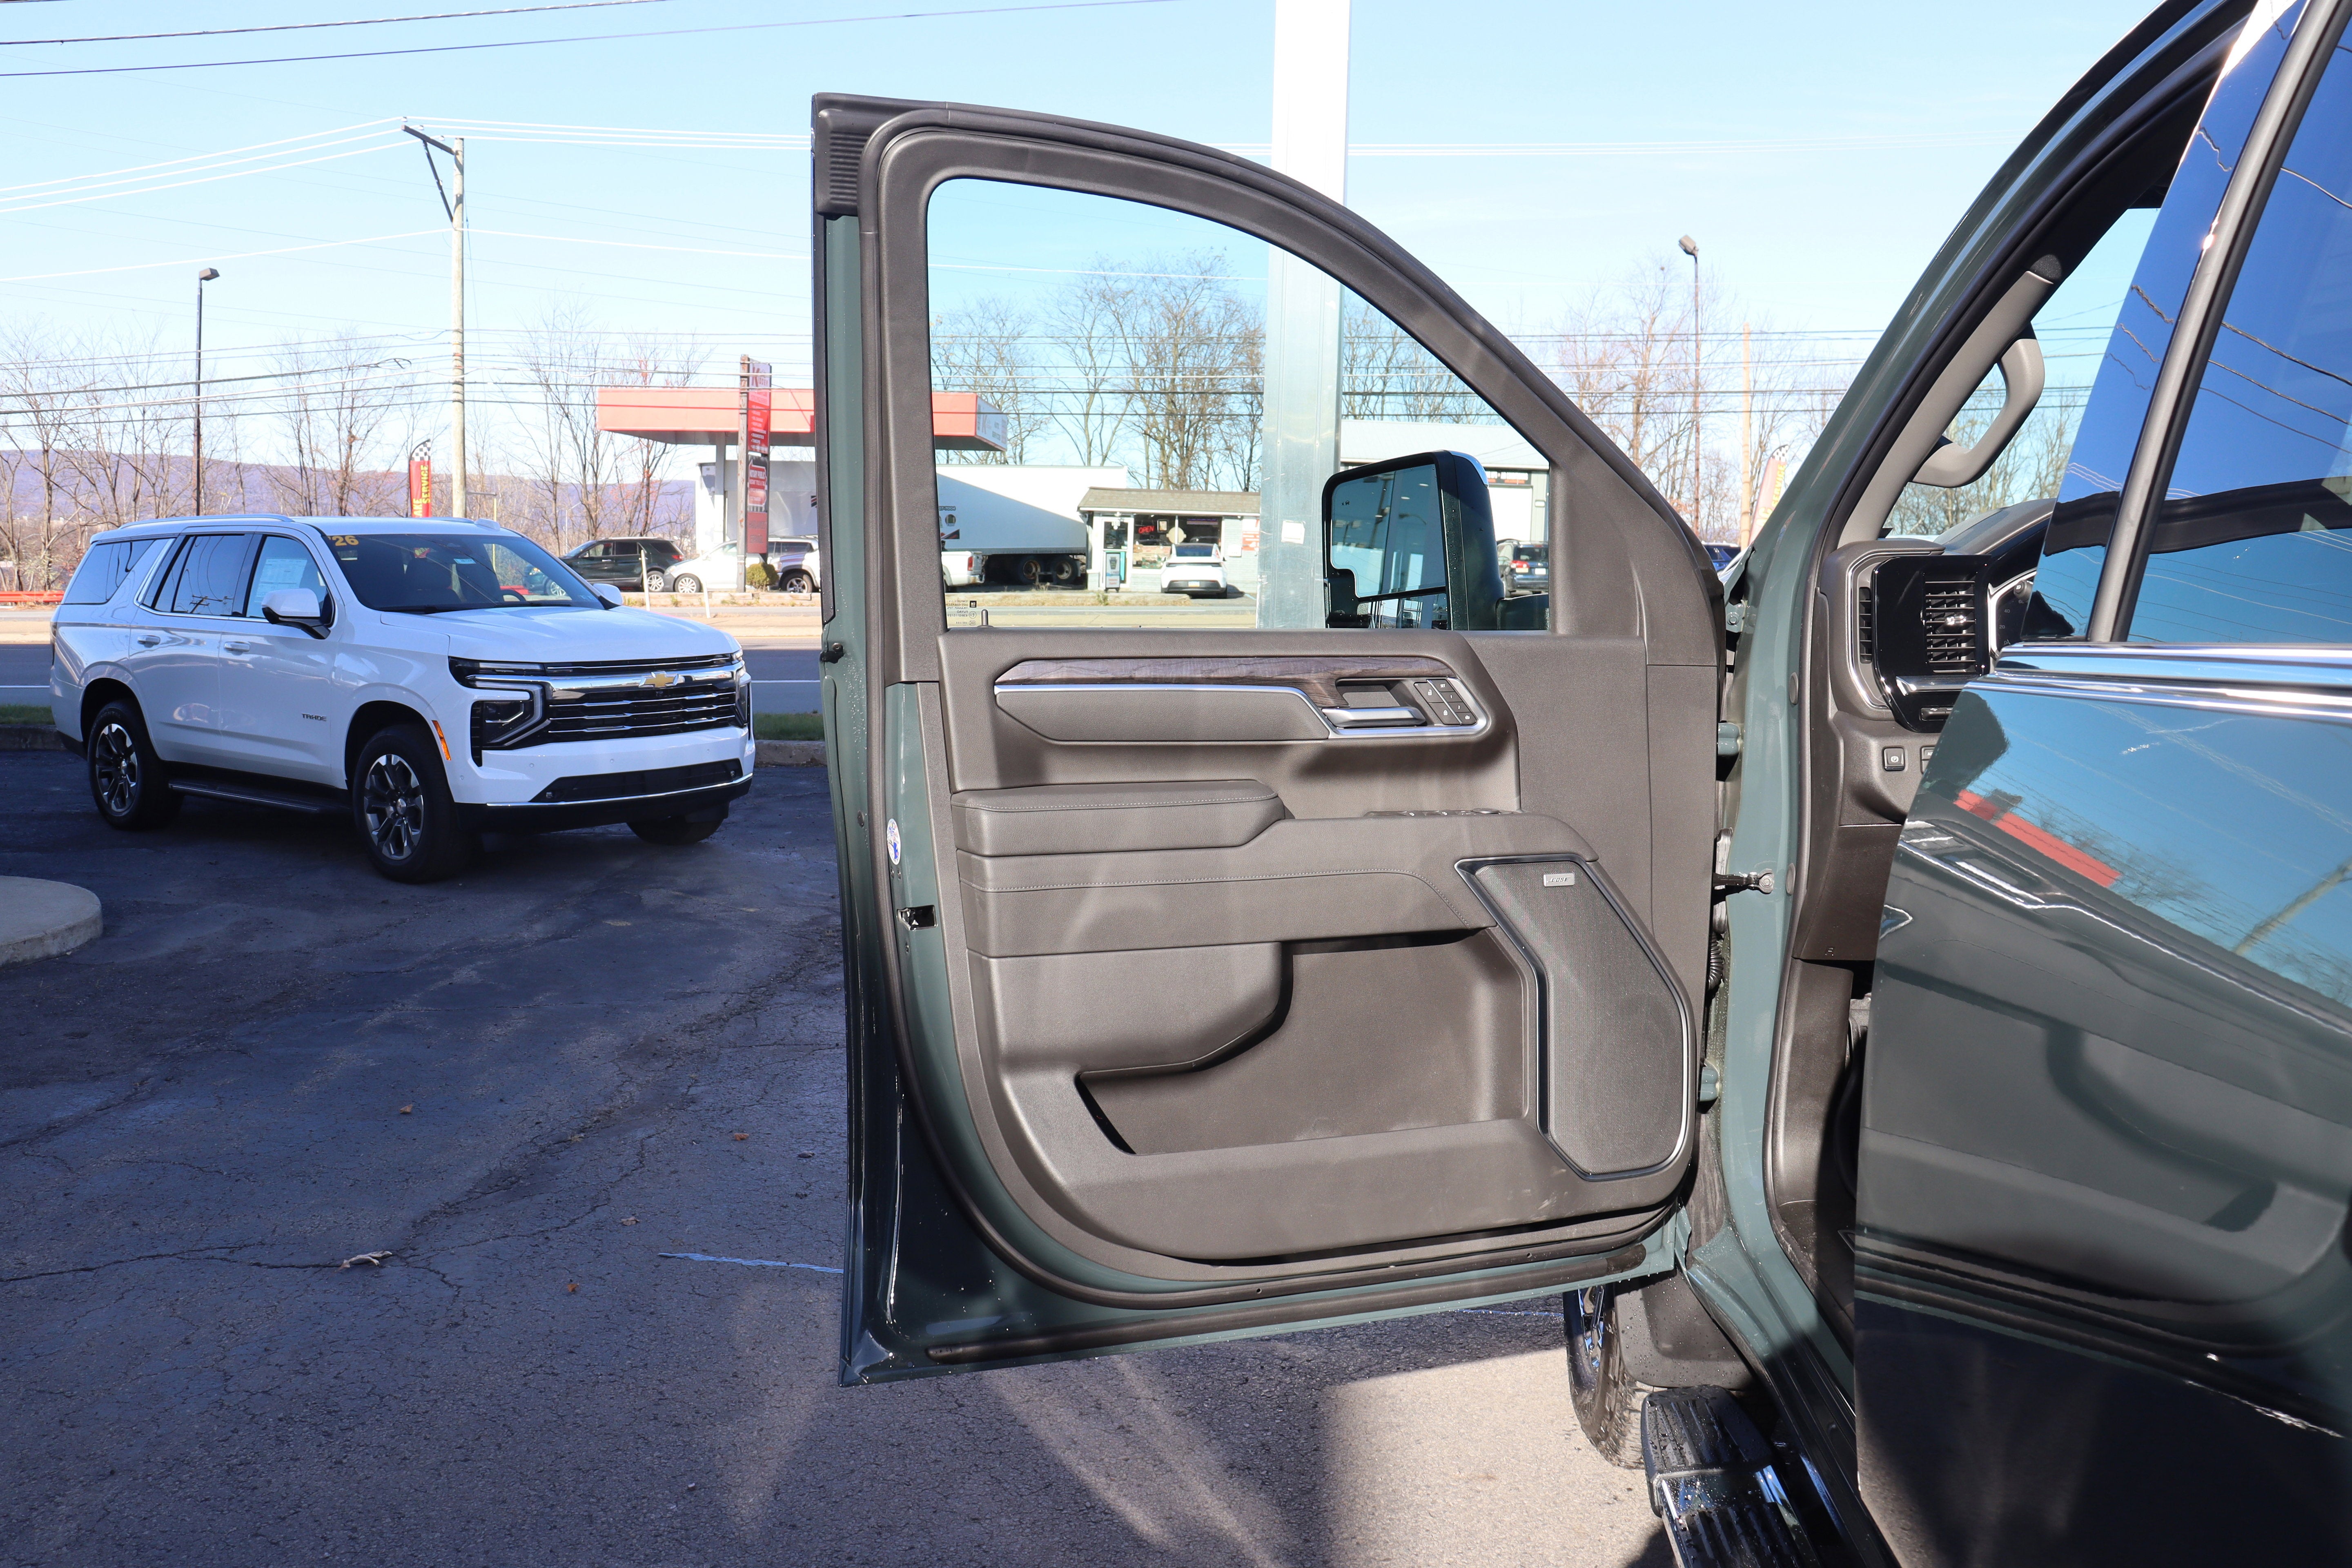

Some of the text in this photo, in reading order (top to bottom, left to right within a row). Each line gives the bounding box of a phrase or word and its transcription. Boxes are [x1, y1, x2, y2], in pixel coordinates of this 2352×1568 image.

[421, 465, 431, 504] SERVICE
[1771, 464, 1786, 507] SERVICE
[413, 498, 422, 517] AKE
[1138, 525, 1155, 533] OPEN
[302, 713, 327, 722] TAHOE
